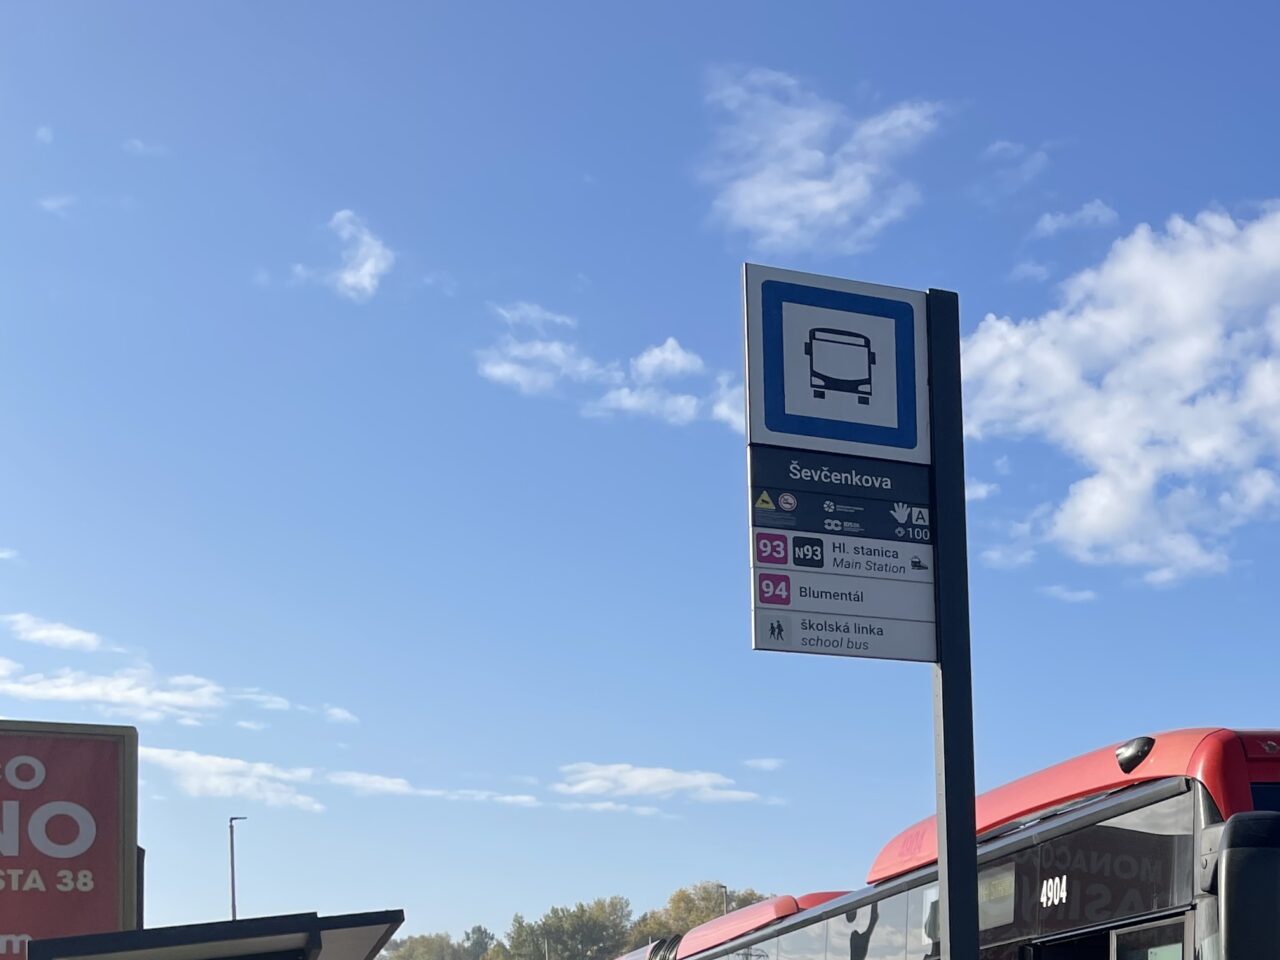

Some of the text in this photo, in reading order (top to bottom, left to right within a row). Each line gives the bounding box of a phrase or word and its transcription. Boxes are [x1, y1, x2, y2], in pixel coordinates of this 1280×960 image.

[789, 460, 892, 489] Ševčenkova
[914, 510, 926, 523] A
[907, 527, 930, 541] 100
[758, 539, 899, 561] 93 N93 Hl. stanica
[832, 557, 906, 575] Main Station
[761, 580, 864, 603] 94 Blumentál
[800, 619, 884, 637] školská linka
[801, 636, 869, 651] school bus
[0, 755, 46, 790] O
[0, 868, 95, 892] TA 38
[1040, 874, 1068, 908] 4904
